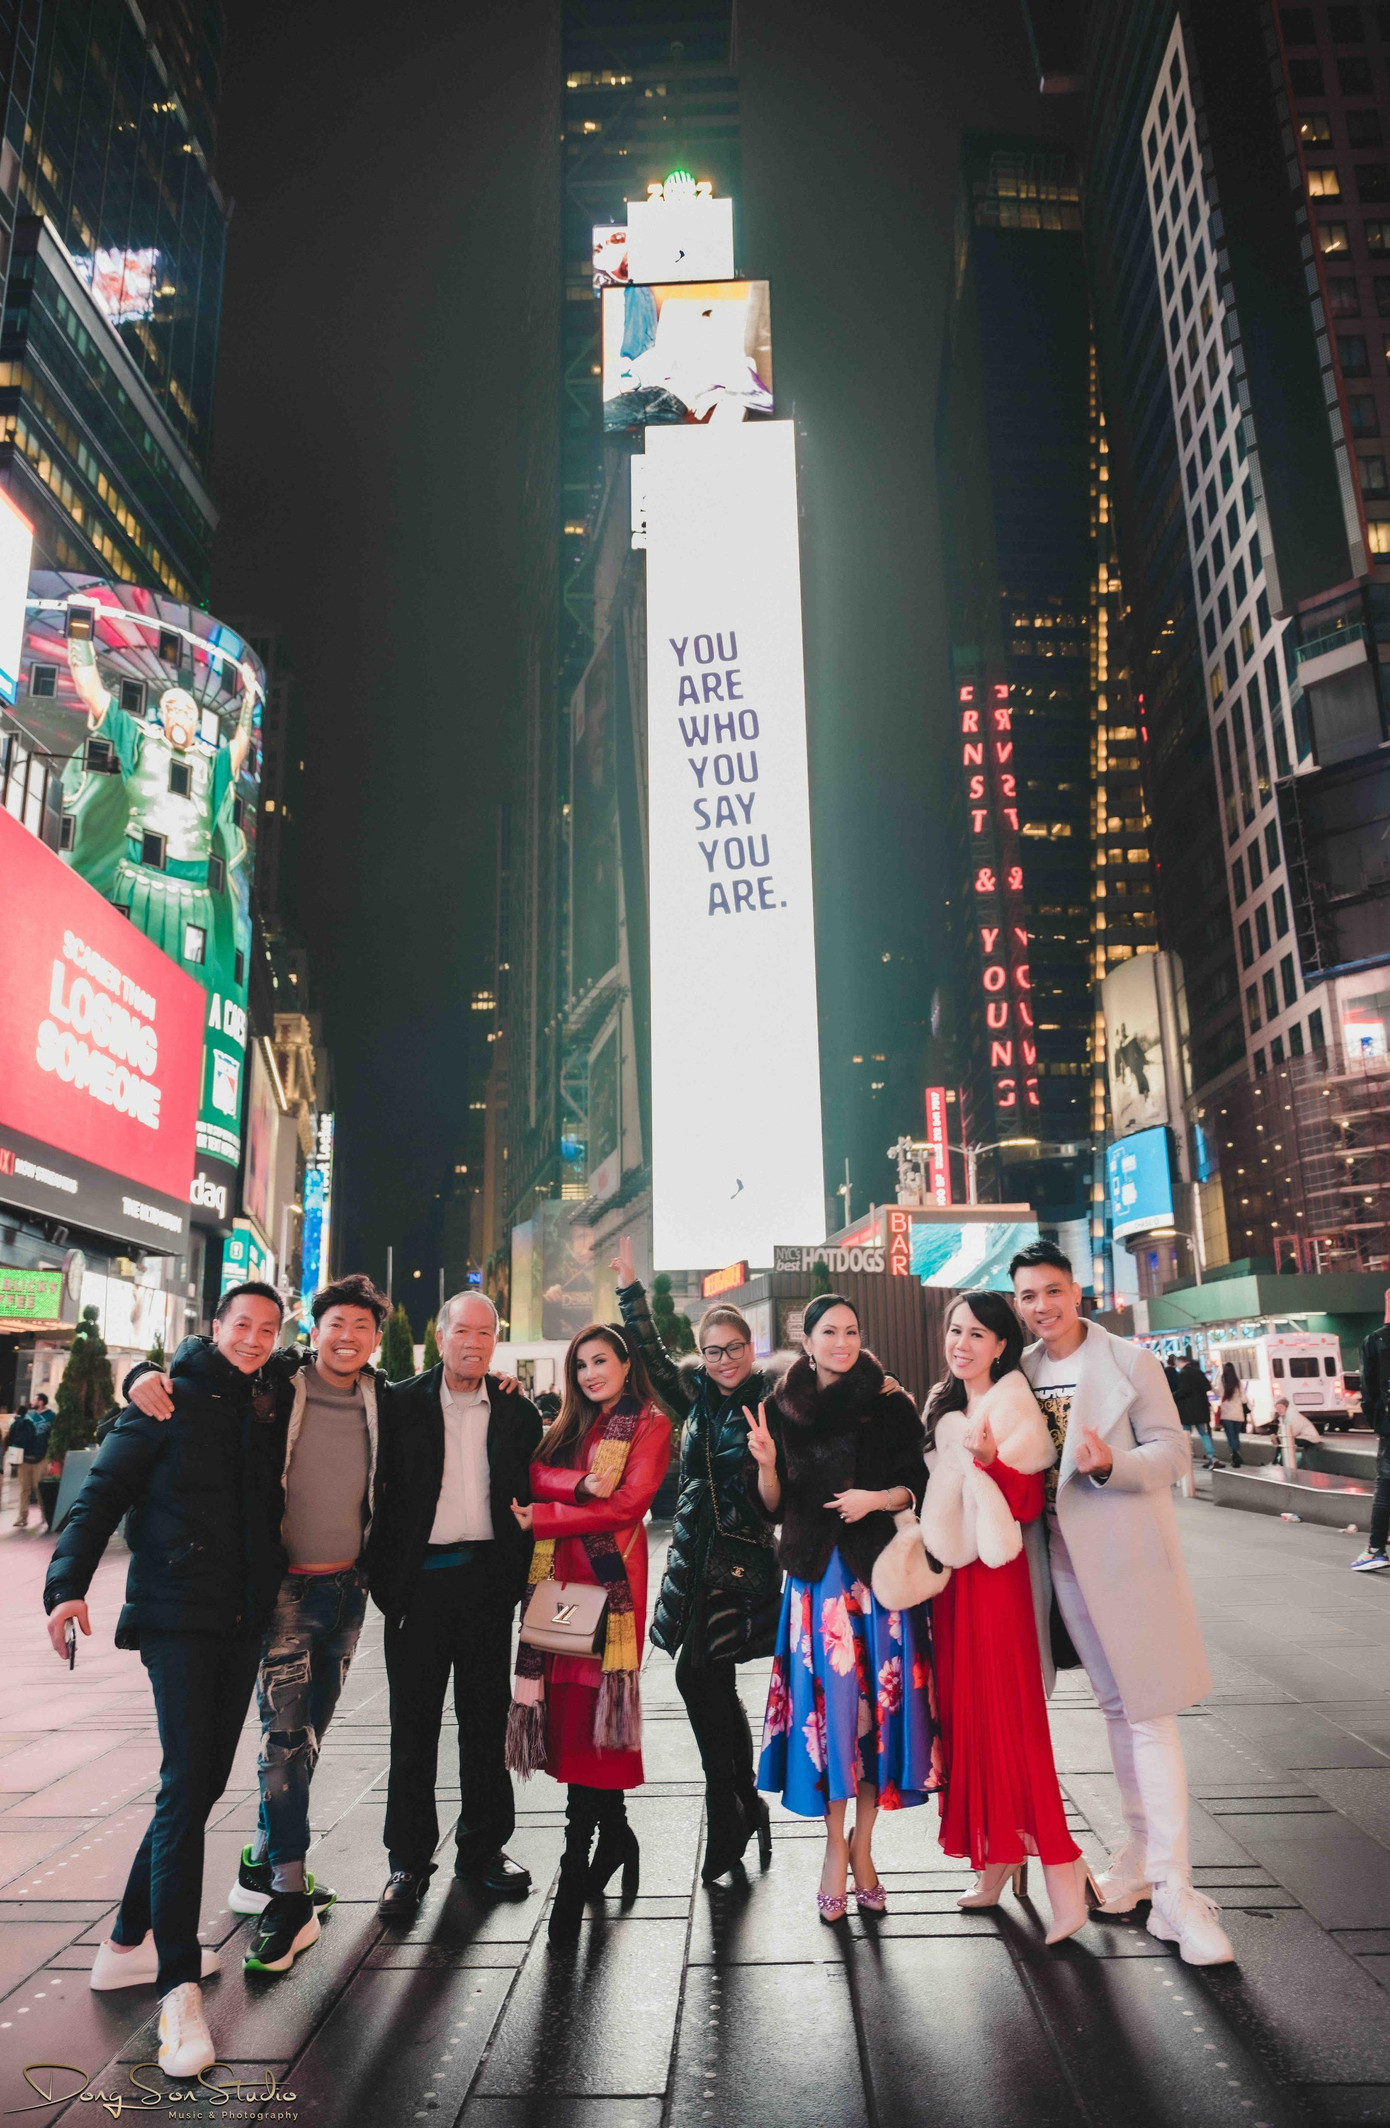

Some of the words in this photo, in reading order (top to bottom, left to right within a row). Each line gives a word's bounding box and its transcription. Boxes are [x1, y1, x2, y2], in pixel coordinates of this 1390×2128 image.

[668, 631, 738, 667] YOU
[678, 669, 744, 706] ARE
[678, 709, 760, 747] WHO
[688, 751, 759, 788] YOU
[693, 792, 755, 831] SAY
[698, 834, 770, 872] YOU
[708, 876, 788, 916] ARE.
[49, 959, 158, 1077] LOSING
[980, 927, 1017, 1107] YOUNG
[36, 1020, 162, 1130] SOMEONE
[890, 1211, 908, 1276] BAR
[776, 1258, 801, 1272] best
